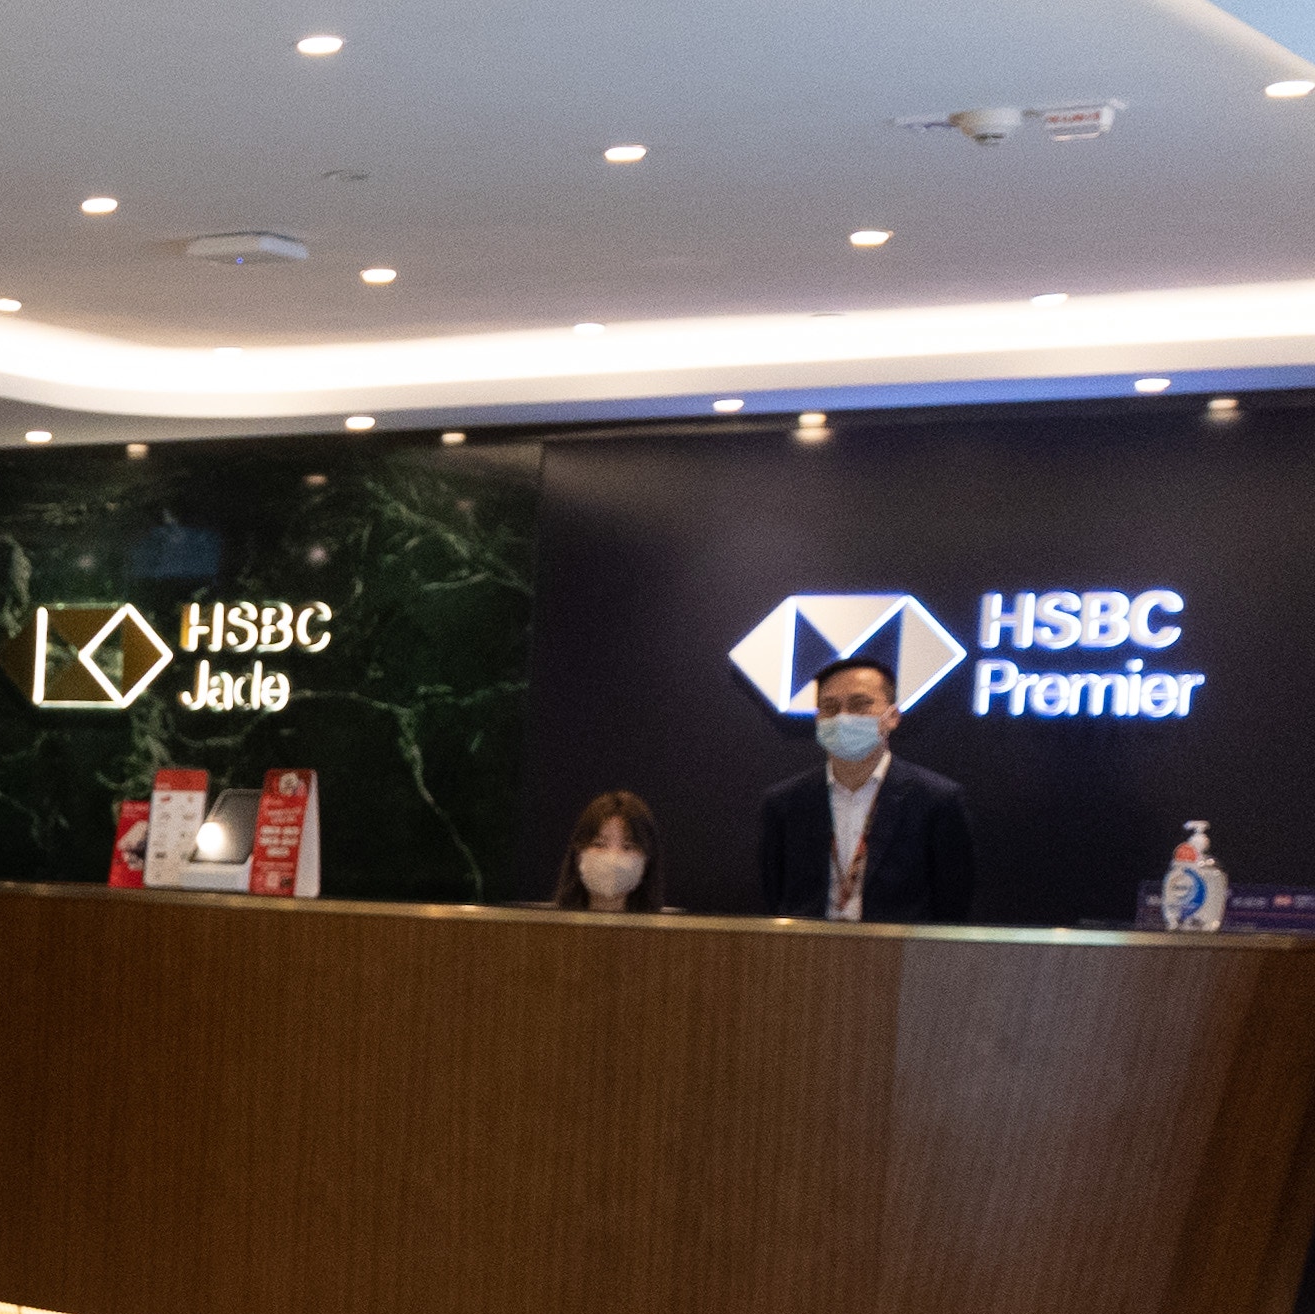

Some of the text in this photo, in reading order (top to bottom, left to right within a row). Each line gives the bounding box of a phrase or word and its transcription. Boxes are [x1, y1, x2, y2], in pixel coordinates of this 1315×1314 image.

[180, 600, 333, 653] HSBC
[977, 588, 1186, 651] HSBC
[179, 658, 291, 712] Jade
[972, 658, 1206, 719] Premier
